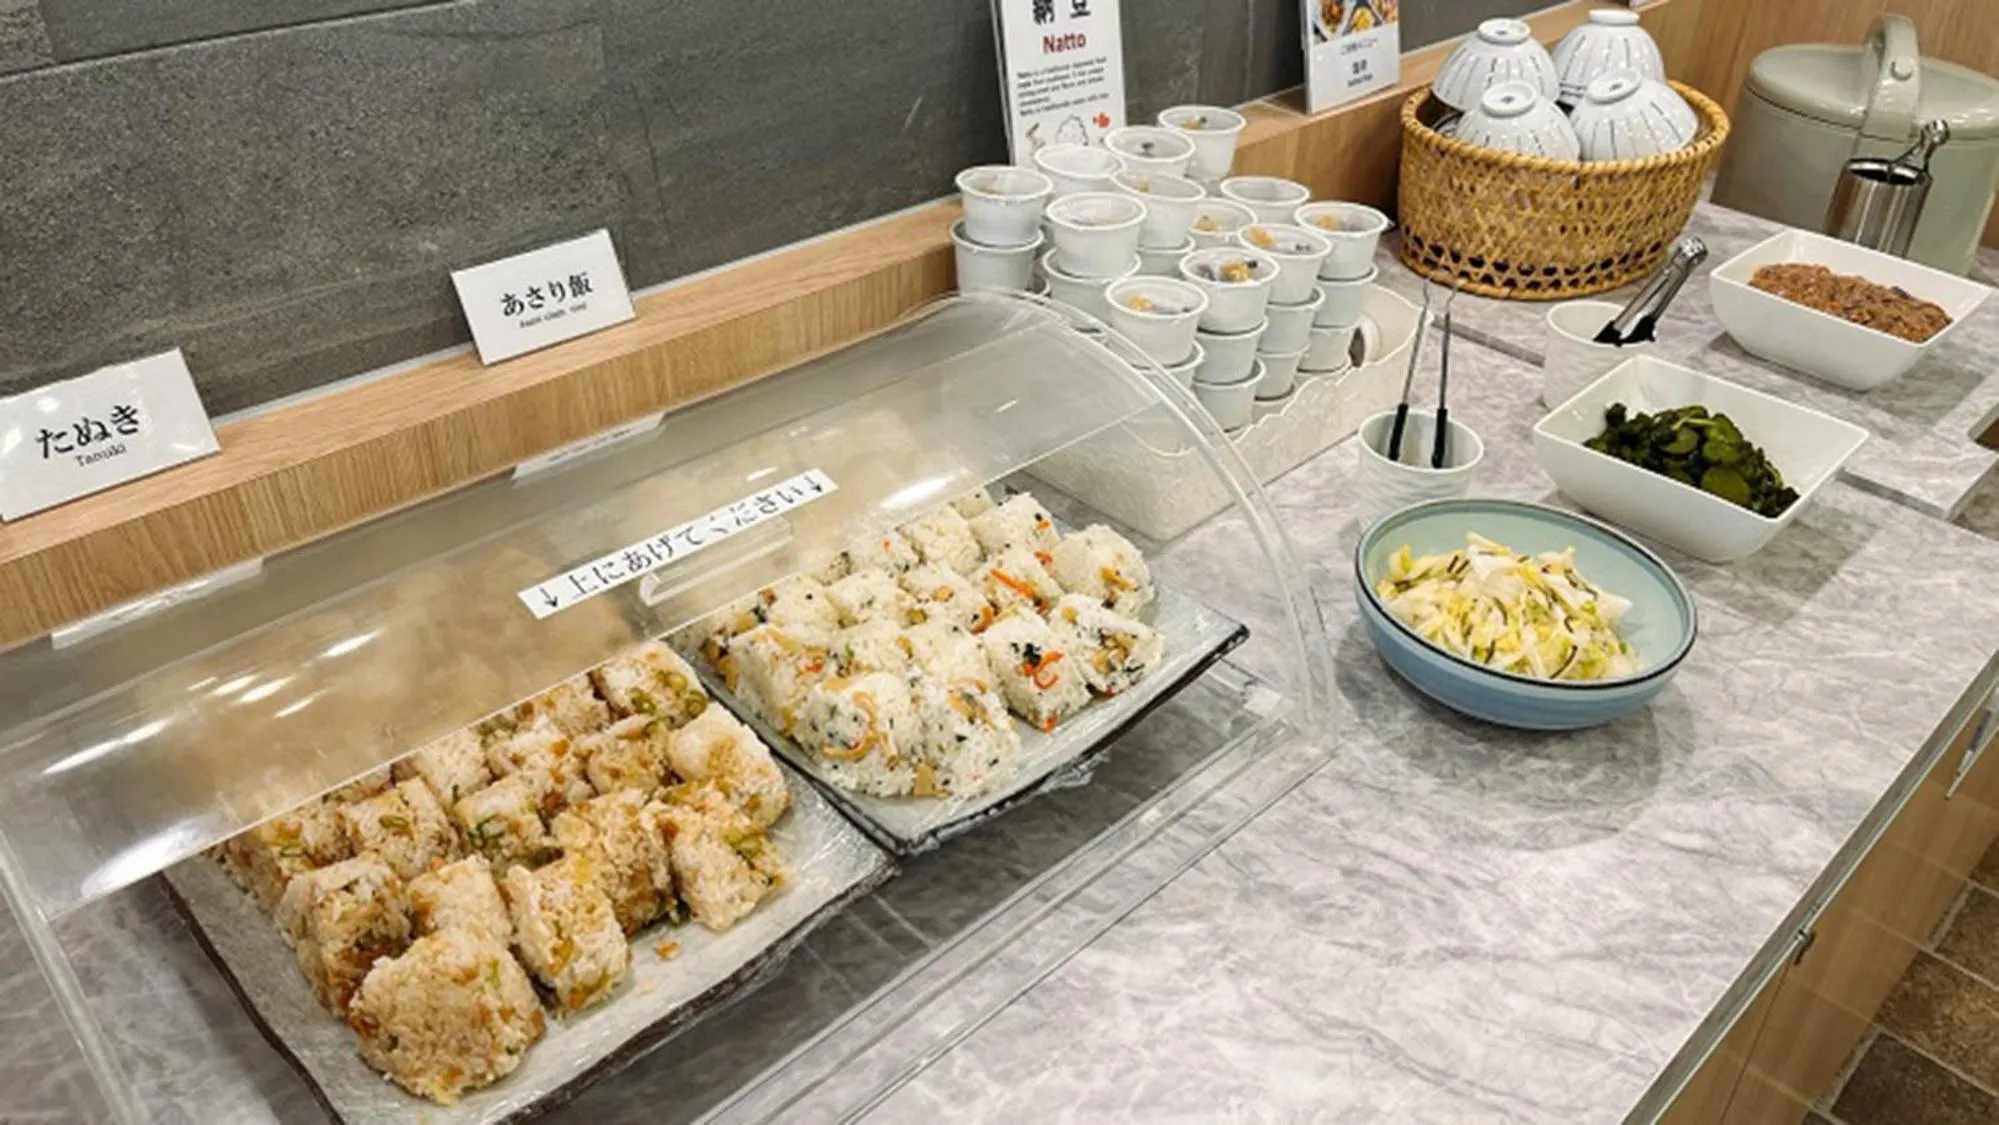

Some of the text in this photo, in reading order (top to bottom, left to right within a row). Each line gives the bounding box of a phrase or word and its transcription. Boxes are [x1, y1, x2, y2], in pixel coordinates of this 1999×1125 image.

[1043, 27, 1086, 54] Natto
[500, 271, 593, 316] あさり飯
[35, 404, 139, 459] たぬき
[75, 443, 127, 467] Tanuki
